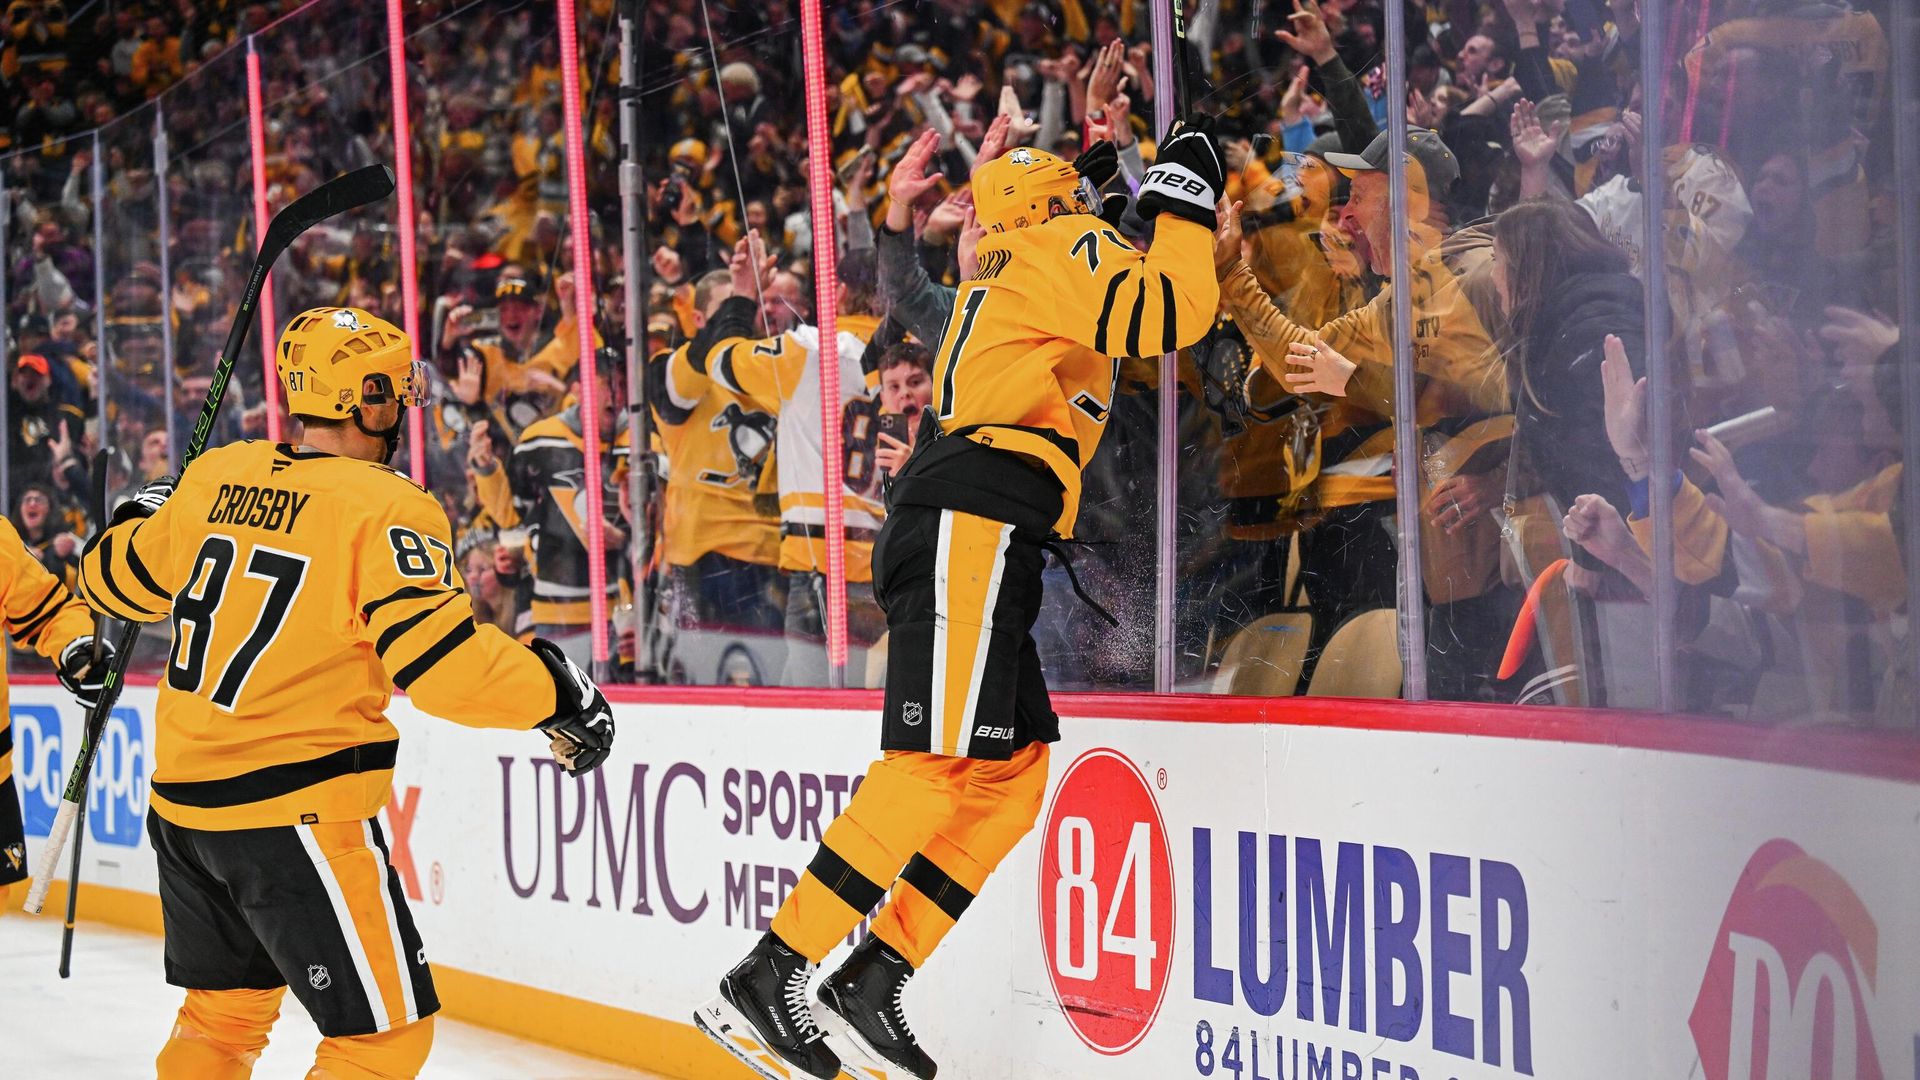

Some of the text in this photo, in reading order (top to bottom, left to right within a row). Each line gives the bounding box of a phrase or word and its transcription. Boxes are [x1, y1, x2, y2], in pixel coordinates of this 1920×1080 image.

[288, 370, 304, 392] 87
[207, 484, 311, 535] CROSBY
[387, 525, 455, 589] 87
[167, 533, 312, 714] 87
[498, 757, 709, 924] UPMC
[1055, 815, 1157, 991] 84
[1193, 826, 1534, 1077] LUMBER
